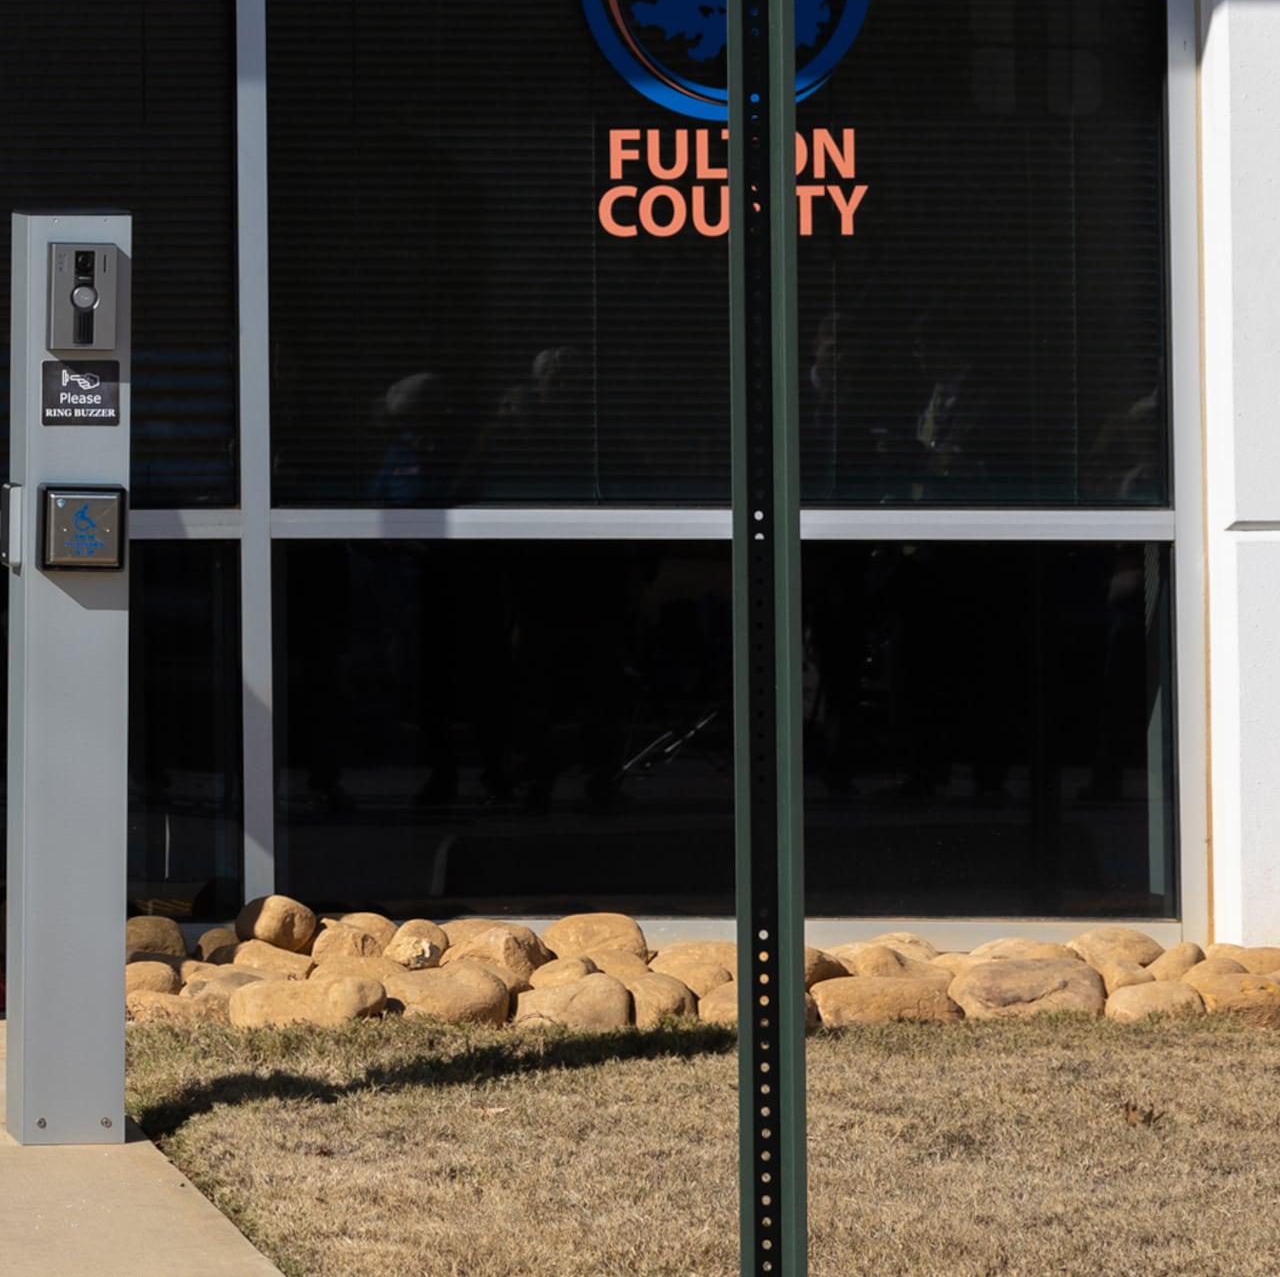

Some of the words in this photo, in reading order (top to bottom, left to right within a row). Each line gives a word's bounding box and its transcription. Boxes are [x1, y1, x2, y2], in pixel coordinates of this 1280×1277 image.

[609, 128, 855, 179] FULN
[598, 185, 869, 237] COUTY
[45, 408, 72, 417] RING
[74, 408, 116, 417] BUZZER
[60, 392, 102, 404] Please
